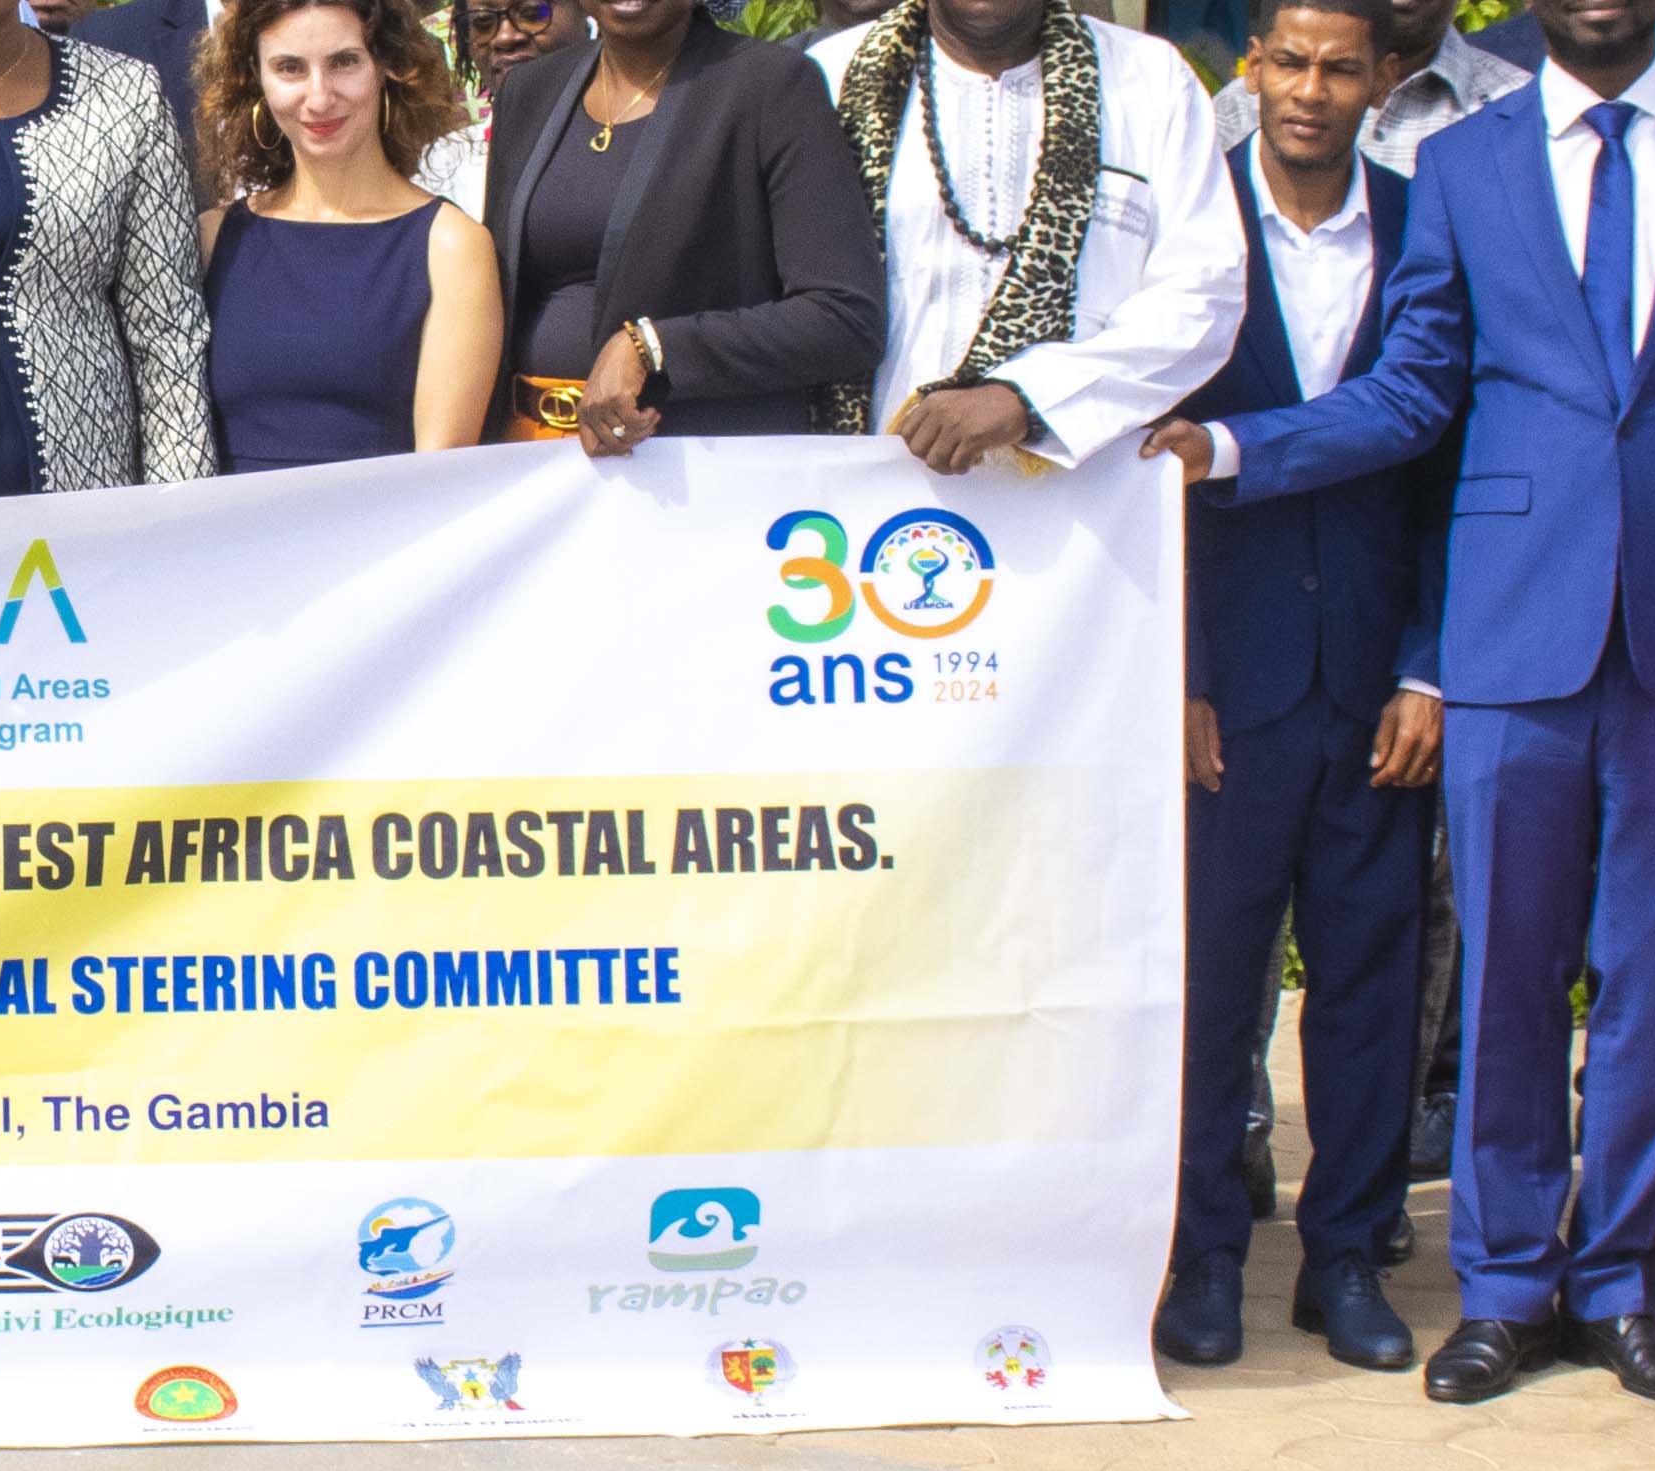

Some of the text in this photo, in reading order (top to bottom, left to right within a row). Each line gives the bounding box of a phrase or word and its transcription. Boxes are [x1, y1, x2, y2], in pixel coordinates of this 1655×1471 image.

[765, 507, 997, 644] 30
[769, 652, 914, 707] ans
[933, 651, 1000, 674] 1994
[11, 673, 111, 700] Areas
[933, 679, 1000, 703] 2024
[125, 814, 356, 885] AFRICA
[371, 808, 656, 880] COASTAL
[670, 803, 895, 874] AREAS.
[72, 952, 337, 1014] STEERING
[353, 947, 682, 1011] COMMITTEE
[43, 1095, 131, 1133] The
[147, 1091, 330, 1131] Gambia
[53, 1303, 235, 1332] Ecologique
[362, 1302, 444, 1322] PRCM
